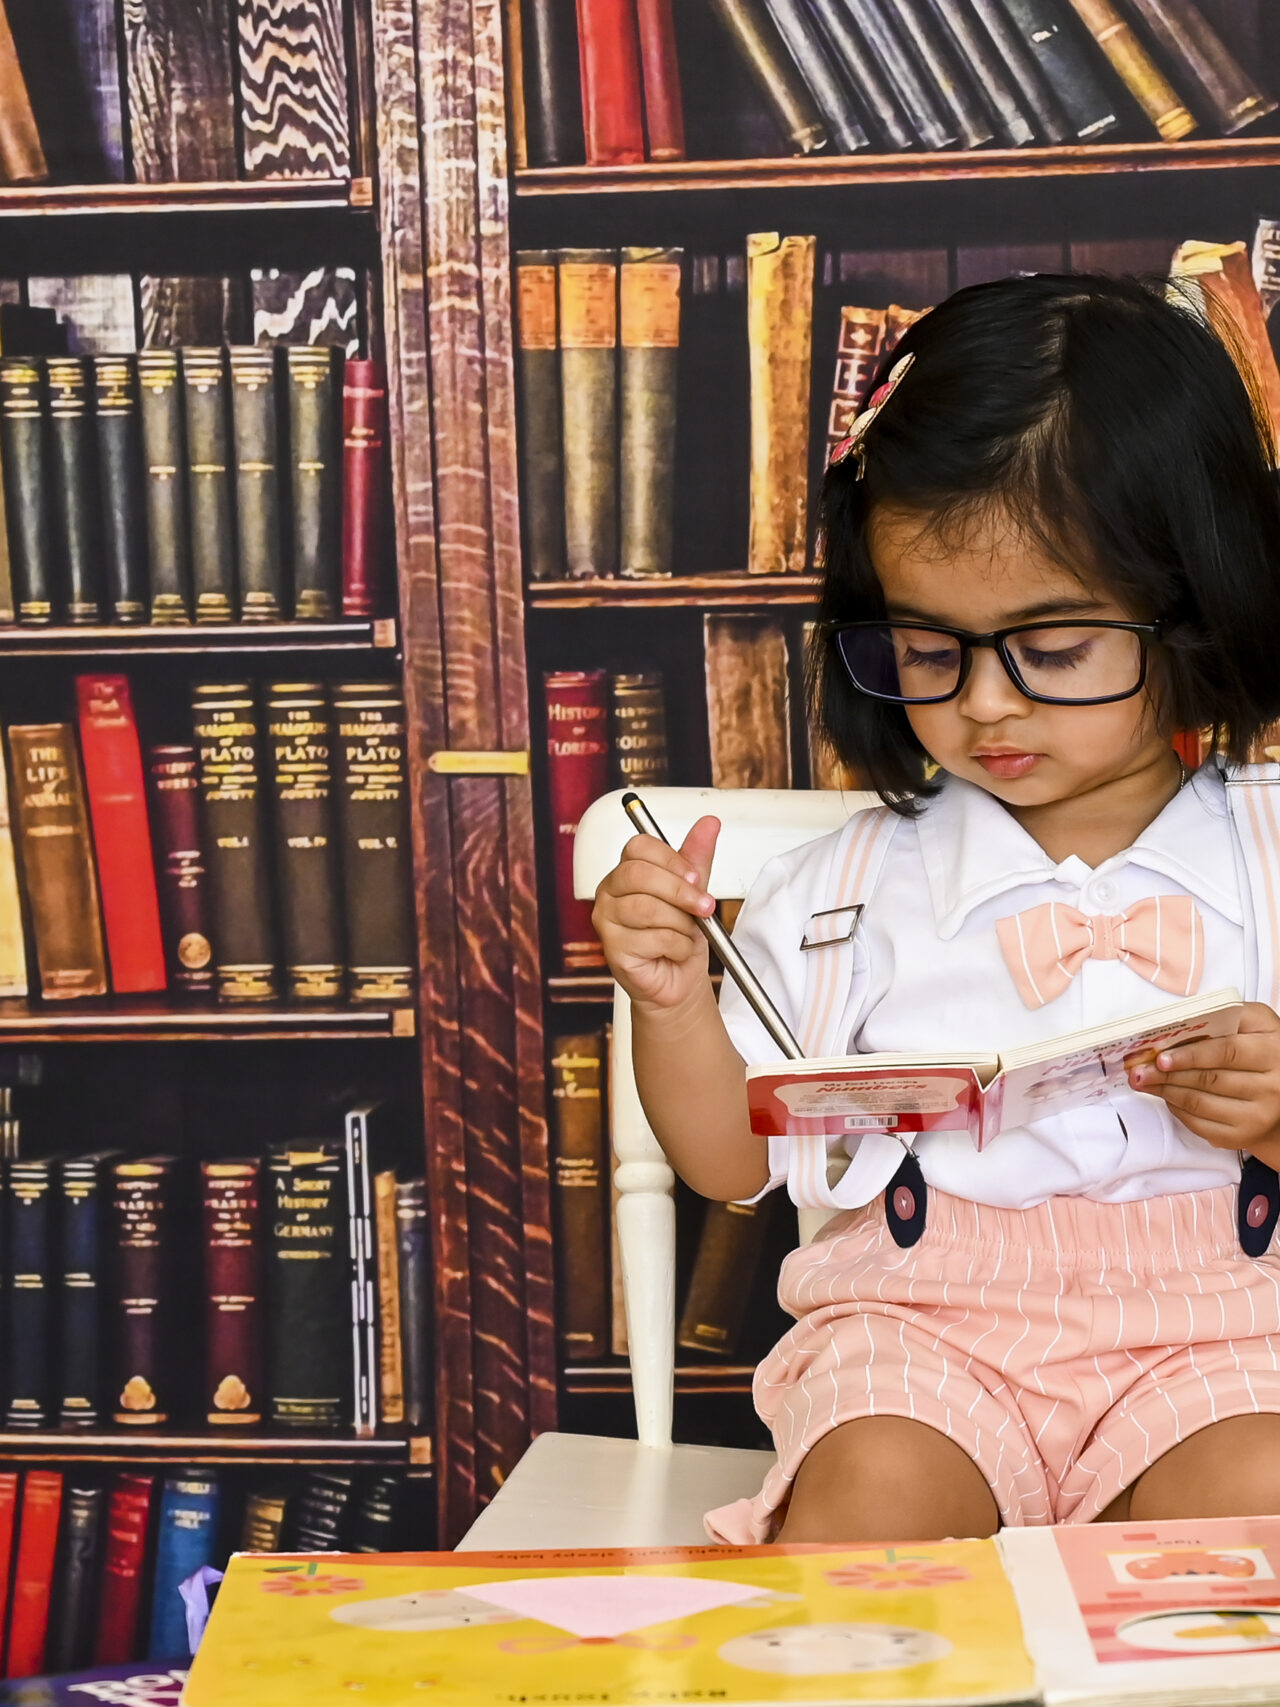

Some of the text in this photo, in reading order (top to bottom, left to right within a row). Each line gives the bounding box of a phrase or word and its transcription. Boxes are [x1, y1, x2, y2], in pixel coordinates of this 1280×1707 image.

[200, 746, 255, 762] PLATO
[275, 746, 329, 761] PLATO
[346, 746, 402, 762] PLATO
[815, 1083, 928, 1094] Numbers
[274, 1223, 334, 1238] GERMANY
